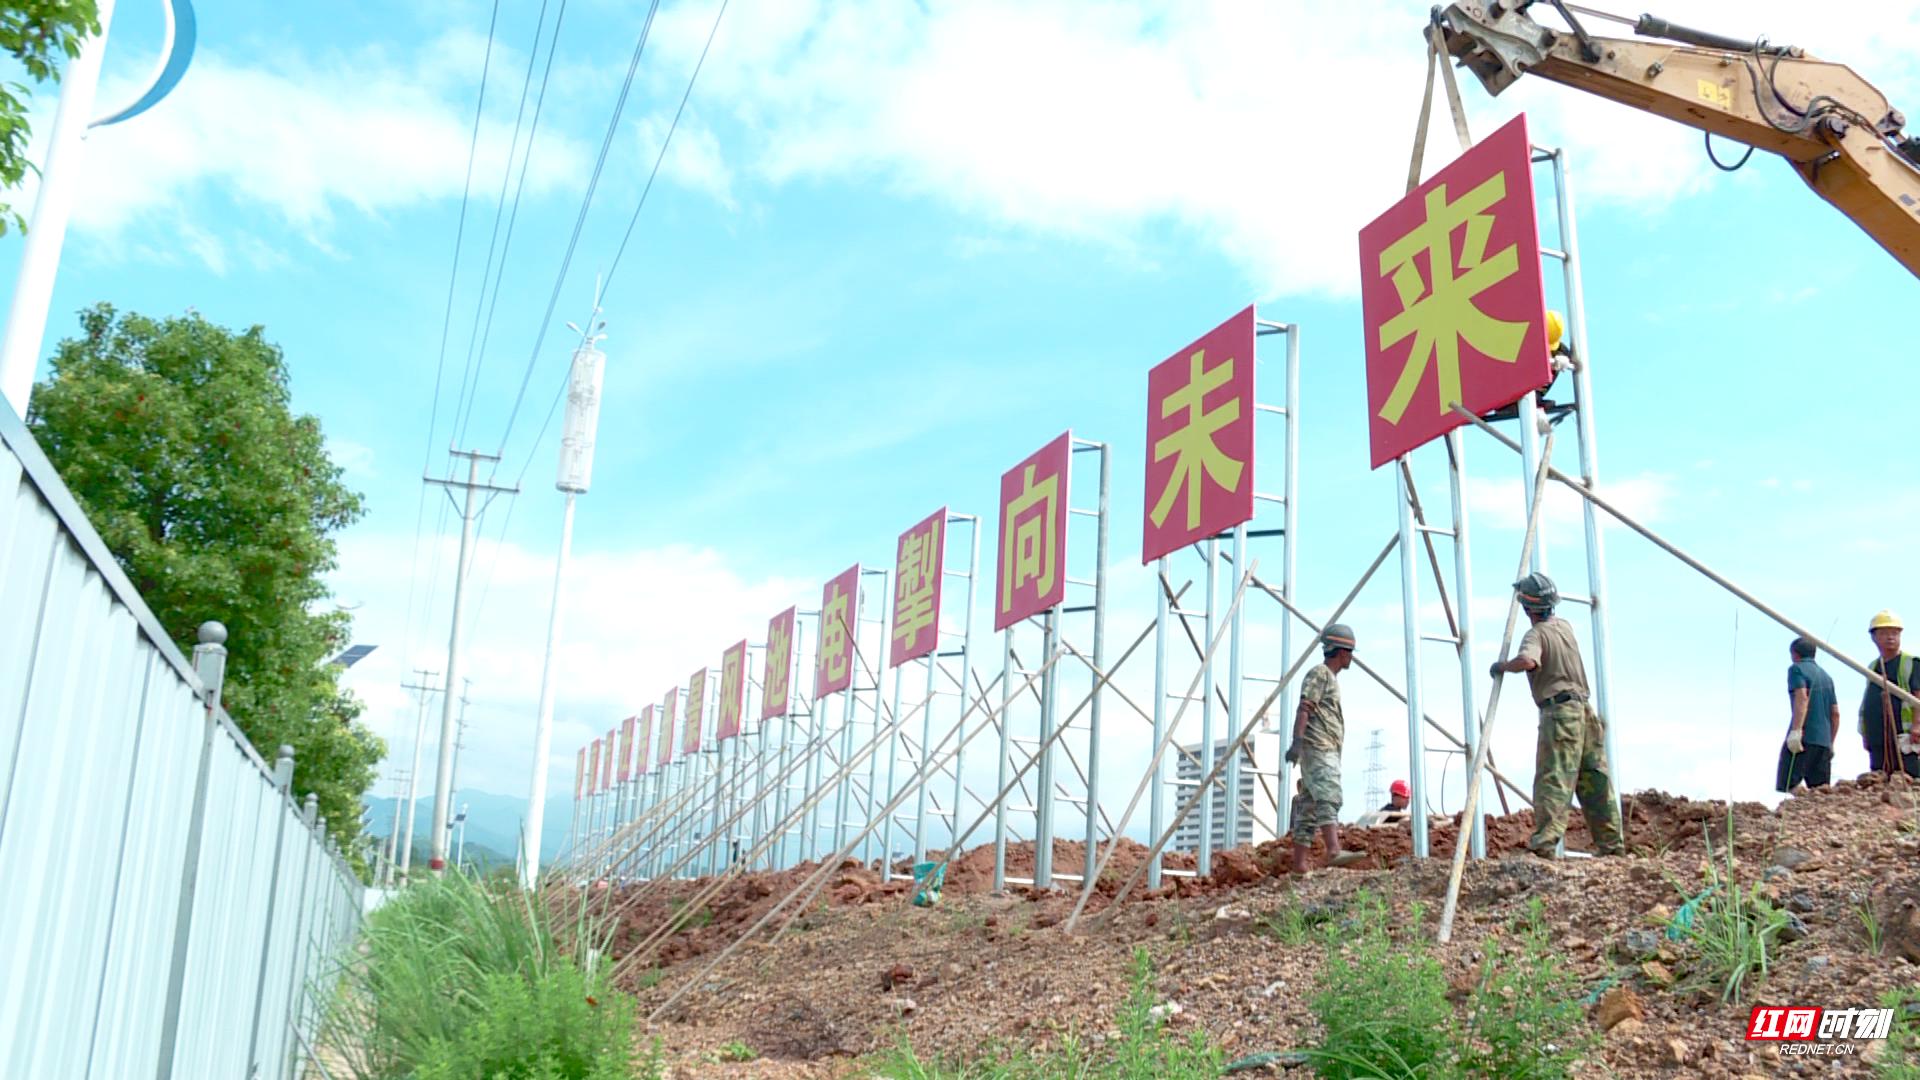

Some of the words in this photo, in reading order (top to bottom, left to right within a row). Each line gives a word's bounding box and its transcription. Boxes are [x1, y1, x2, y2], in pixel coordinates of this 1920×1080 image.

[763, 617, 789, 708] 池
[820, 584, 849, 683] 电
[893, 520, 940, 651] 掣
[1001, 464, 1060, 614] 向
[1149, 348, 1244, 531] 未
[1377, 170, 1530, 426] 来
